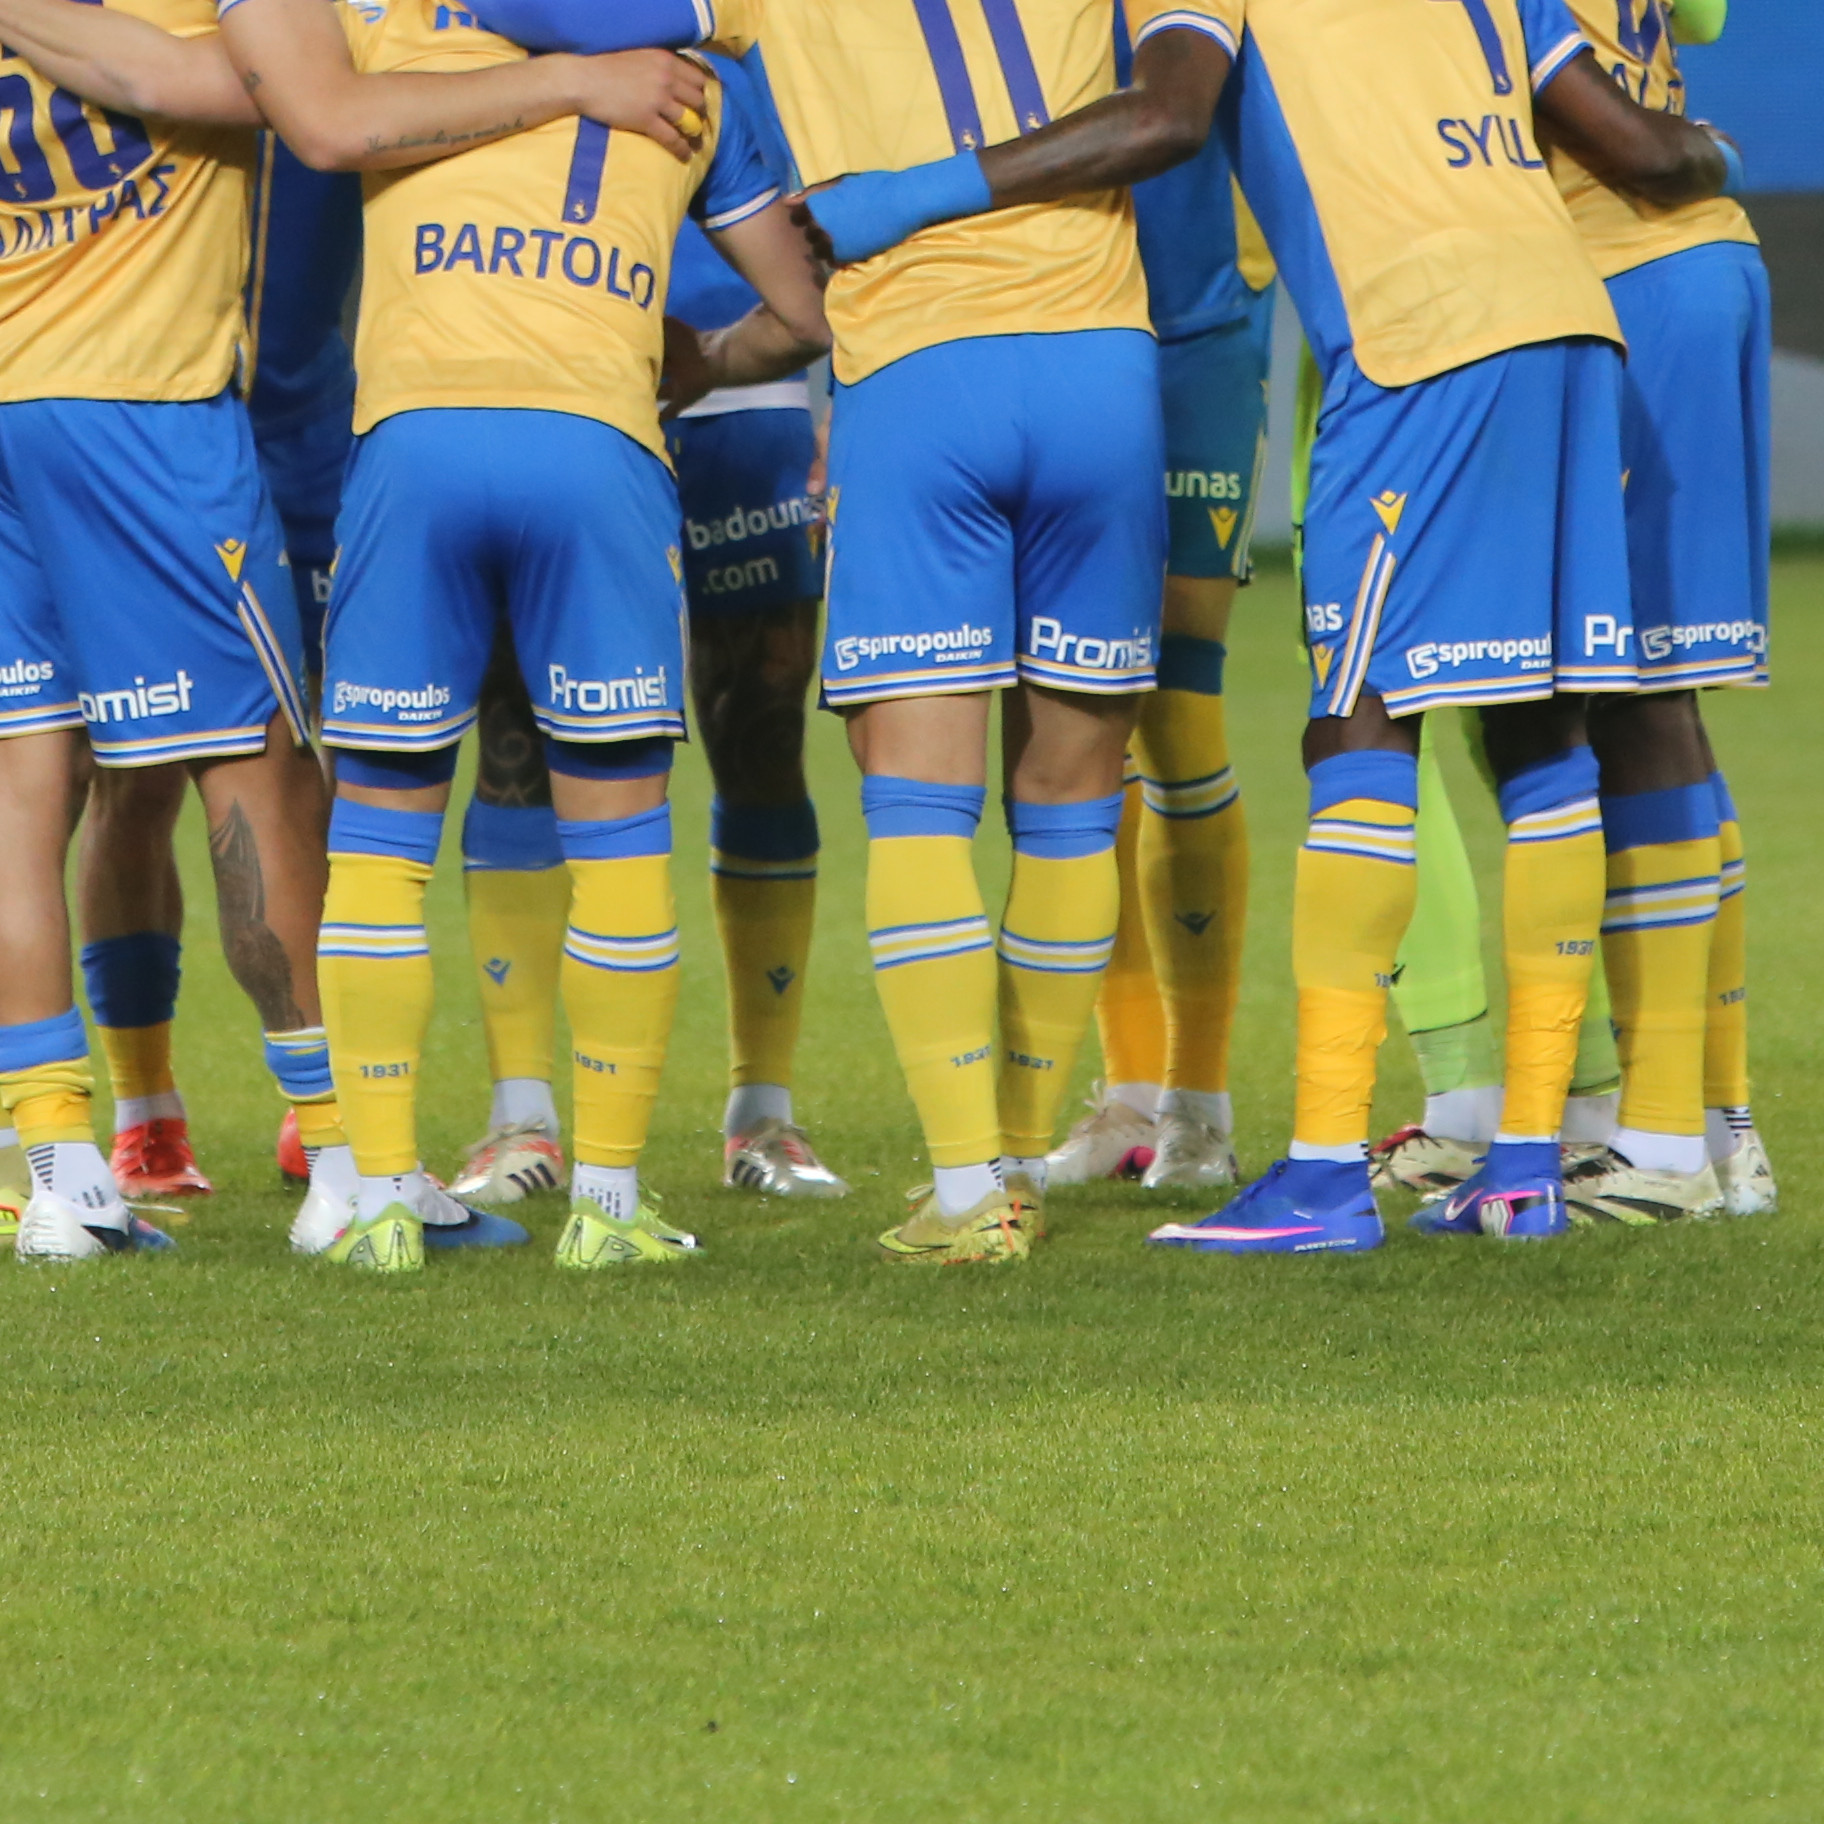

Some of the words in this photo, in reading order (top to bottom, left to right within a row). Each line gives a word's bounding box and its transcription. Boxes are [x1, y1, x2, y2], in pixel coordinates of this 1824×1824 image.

[415, 223, 655, 311] BARTOLO
[702, 557, 779, 594] .com
[858, 623, 993, 660] spiropoulos
[934, 650, 983, 664] DAIKIN
[77, 669, 194, 724] omist
[548, 663, 668, 713] Promist
